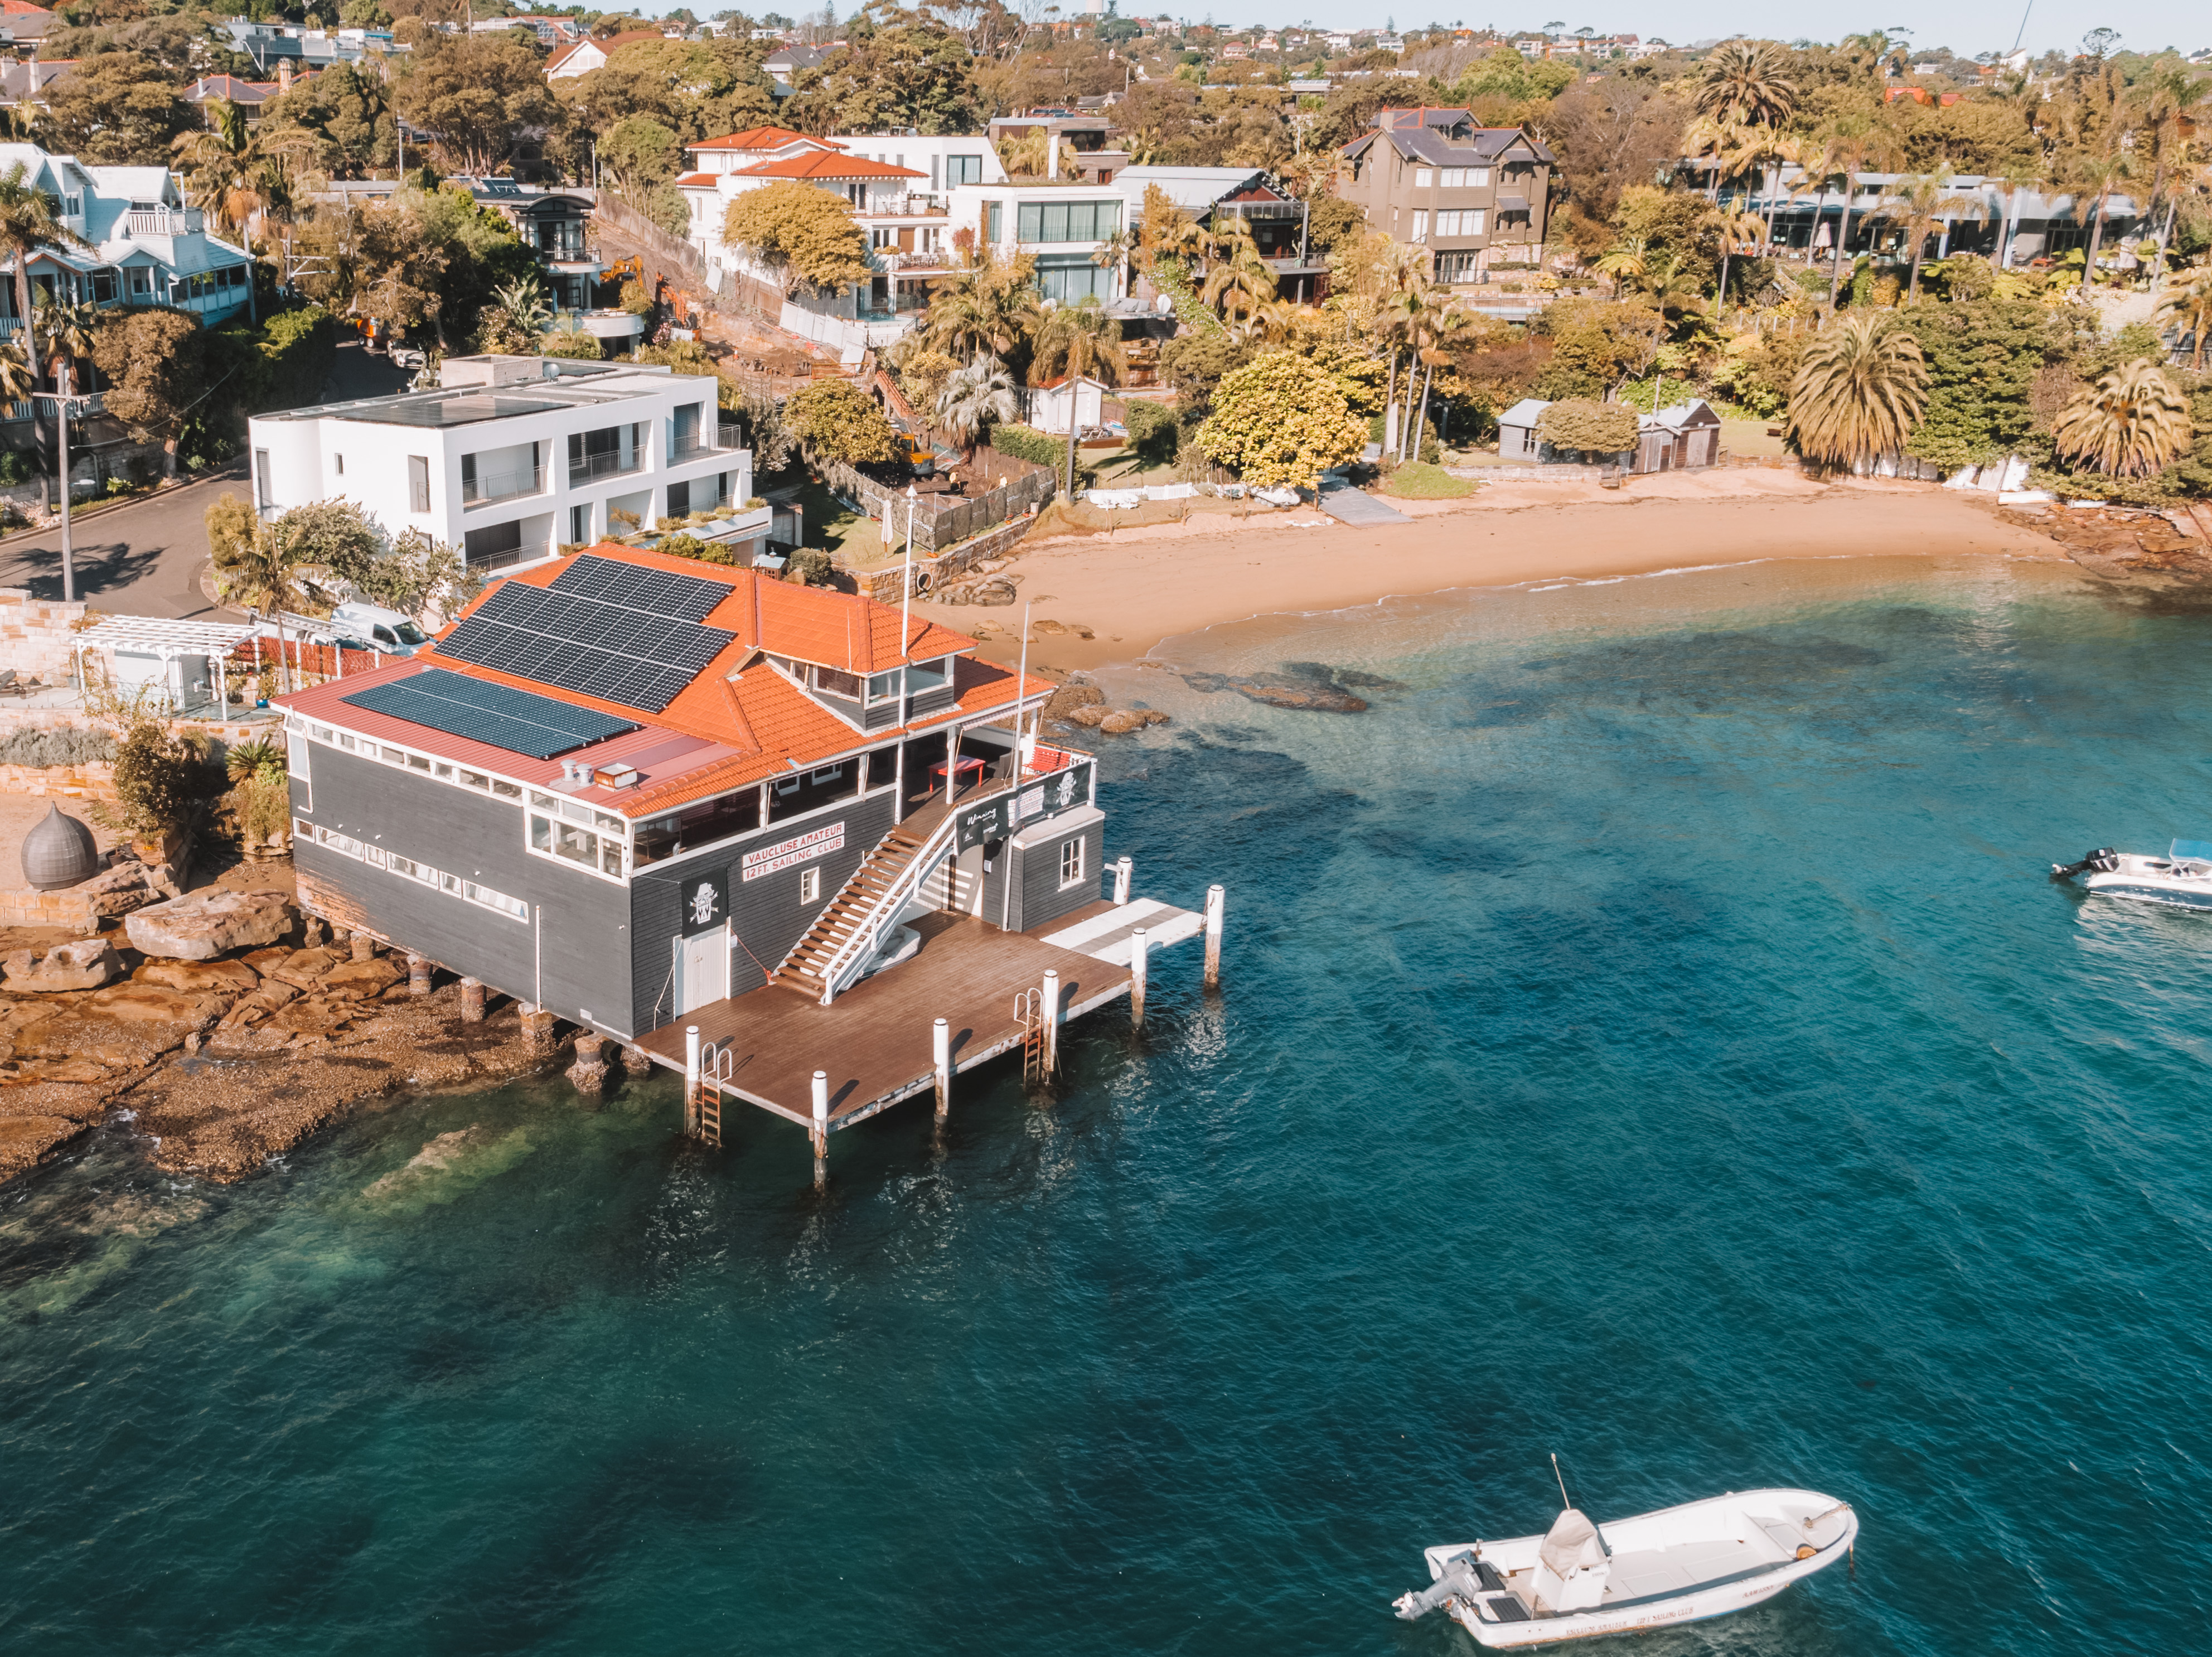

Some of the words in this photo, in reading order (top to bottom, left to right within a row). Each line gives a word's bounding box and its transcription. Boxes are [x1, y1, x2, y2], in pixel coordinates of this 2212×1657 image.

[967, 808, 996, 825] Winning
[748, 839, 798, 864] VAUCLUSE
[800, 824, 842, 847] AMATEUR
[772, 849, 812, 870] SAILING
[817, 838, 842, 853] CLUB
[1652, 1611, 1676, 1622] SAILING
[1677, 1606, 1693, 1616] CLUB
